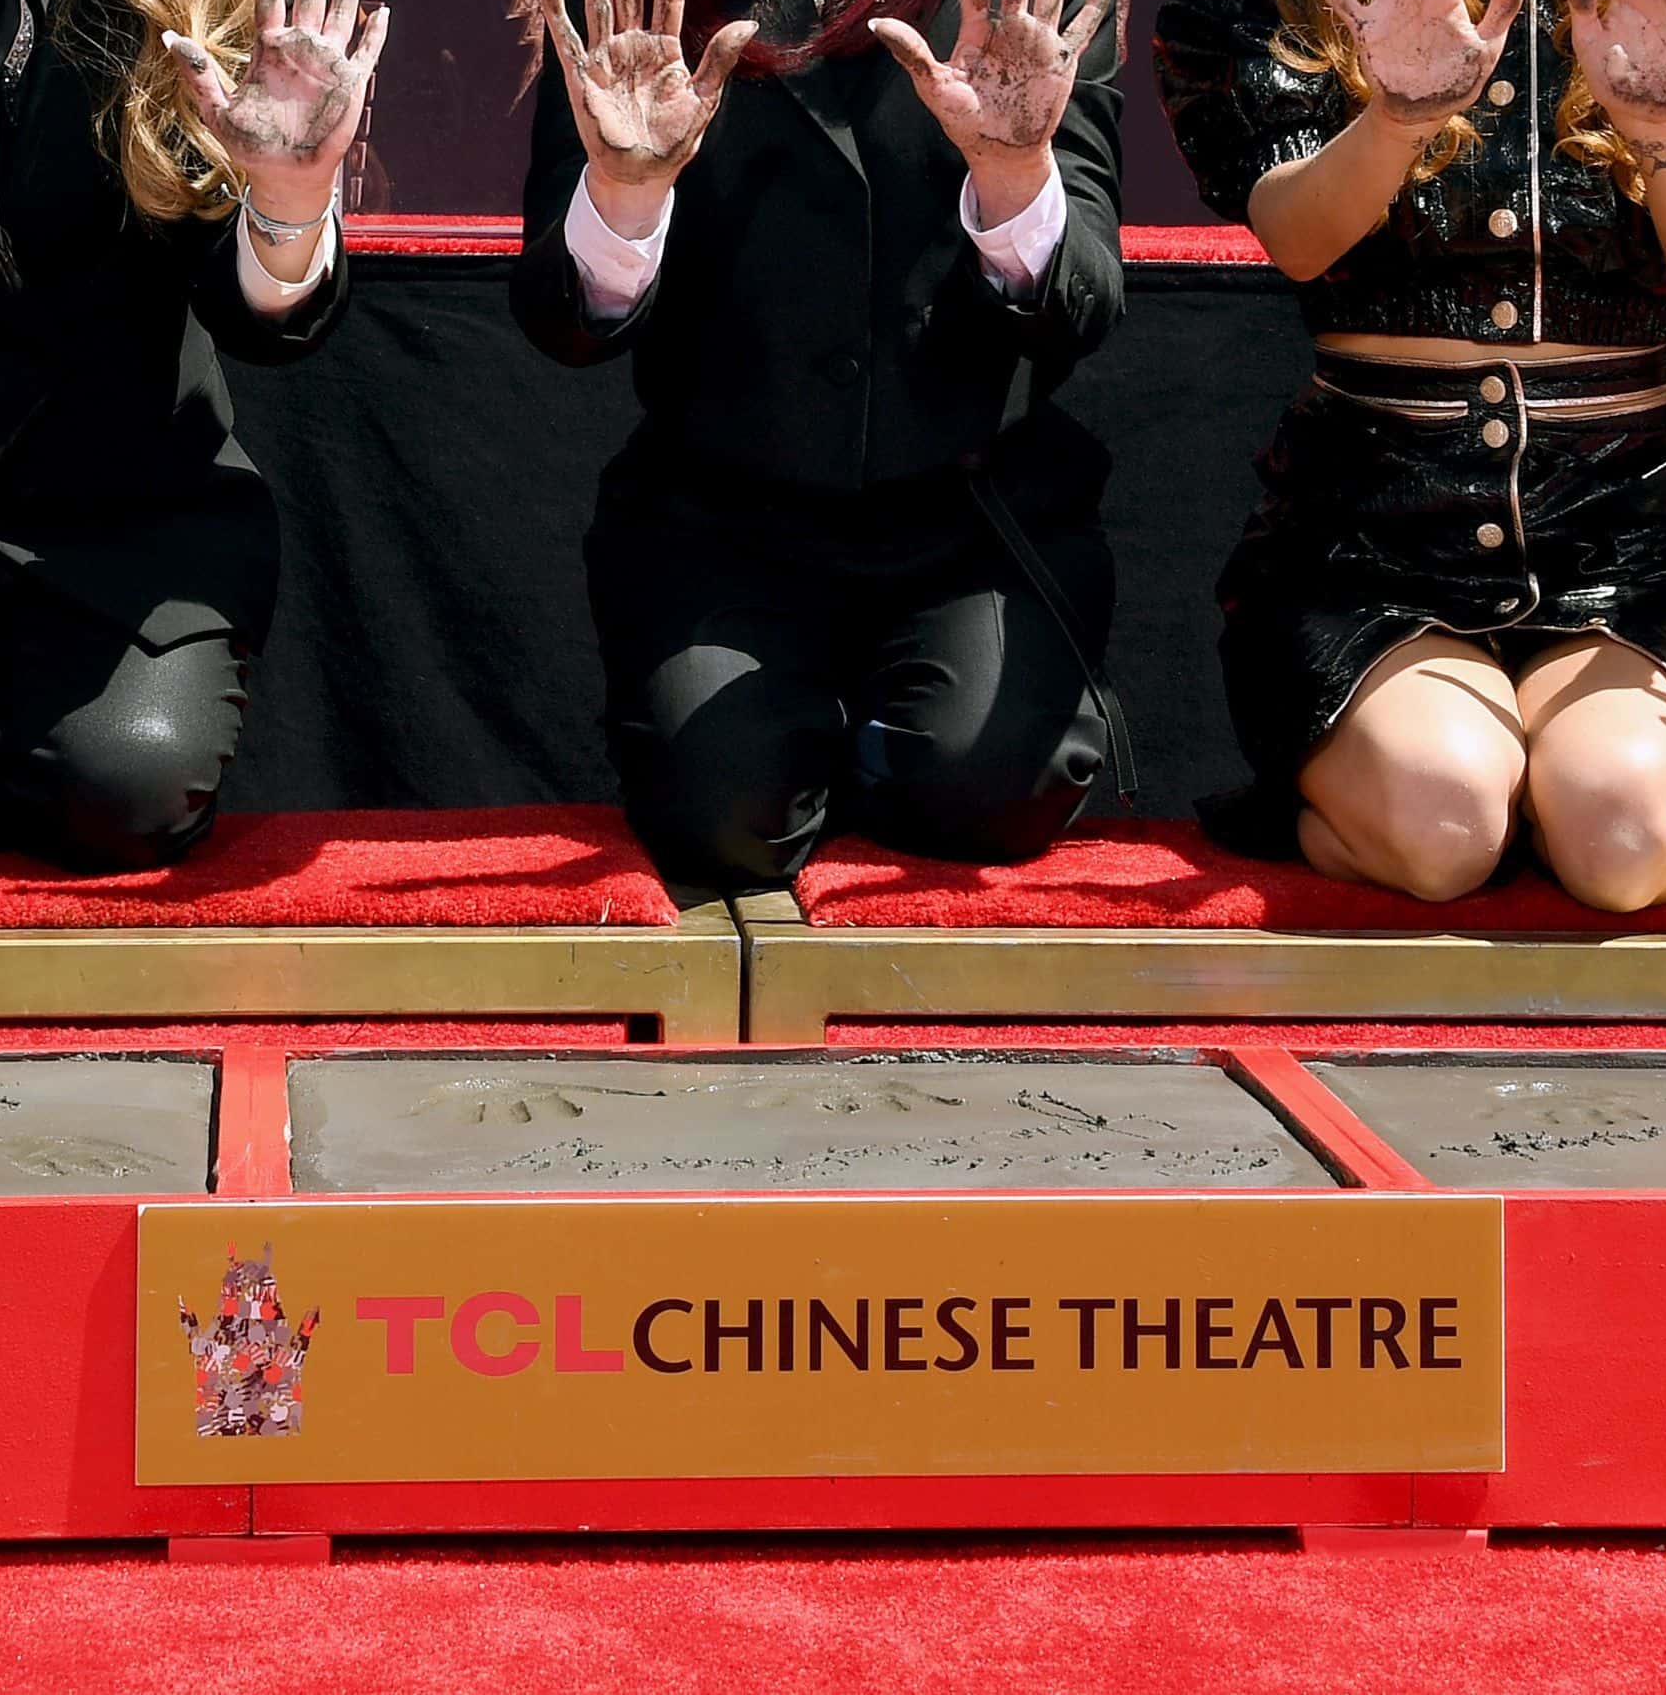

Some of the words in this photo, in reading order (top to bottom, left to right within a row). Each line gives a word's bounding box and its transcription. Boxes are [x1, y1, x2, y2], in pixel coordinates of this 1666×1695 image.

[355, 1292, 626, 1377] TCL
[633, 1297, 1035, 1374] CHINESE
[1058, 1297, 1462, 1370] THEATRE
